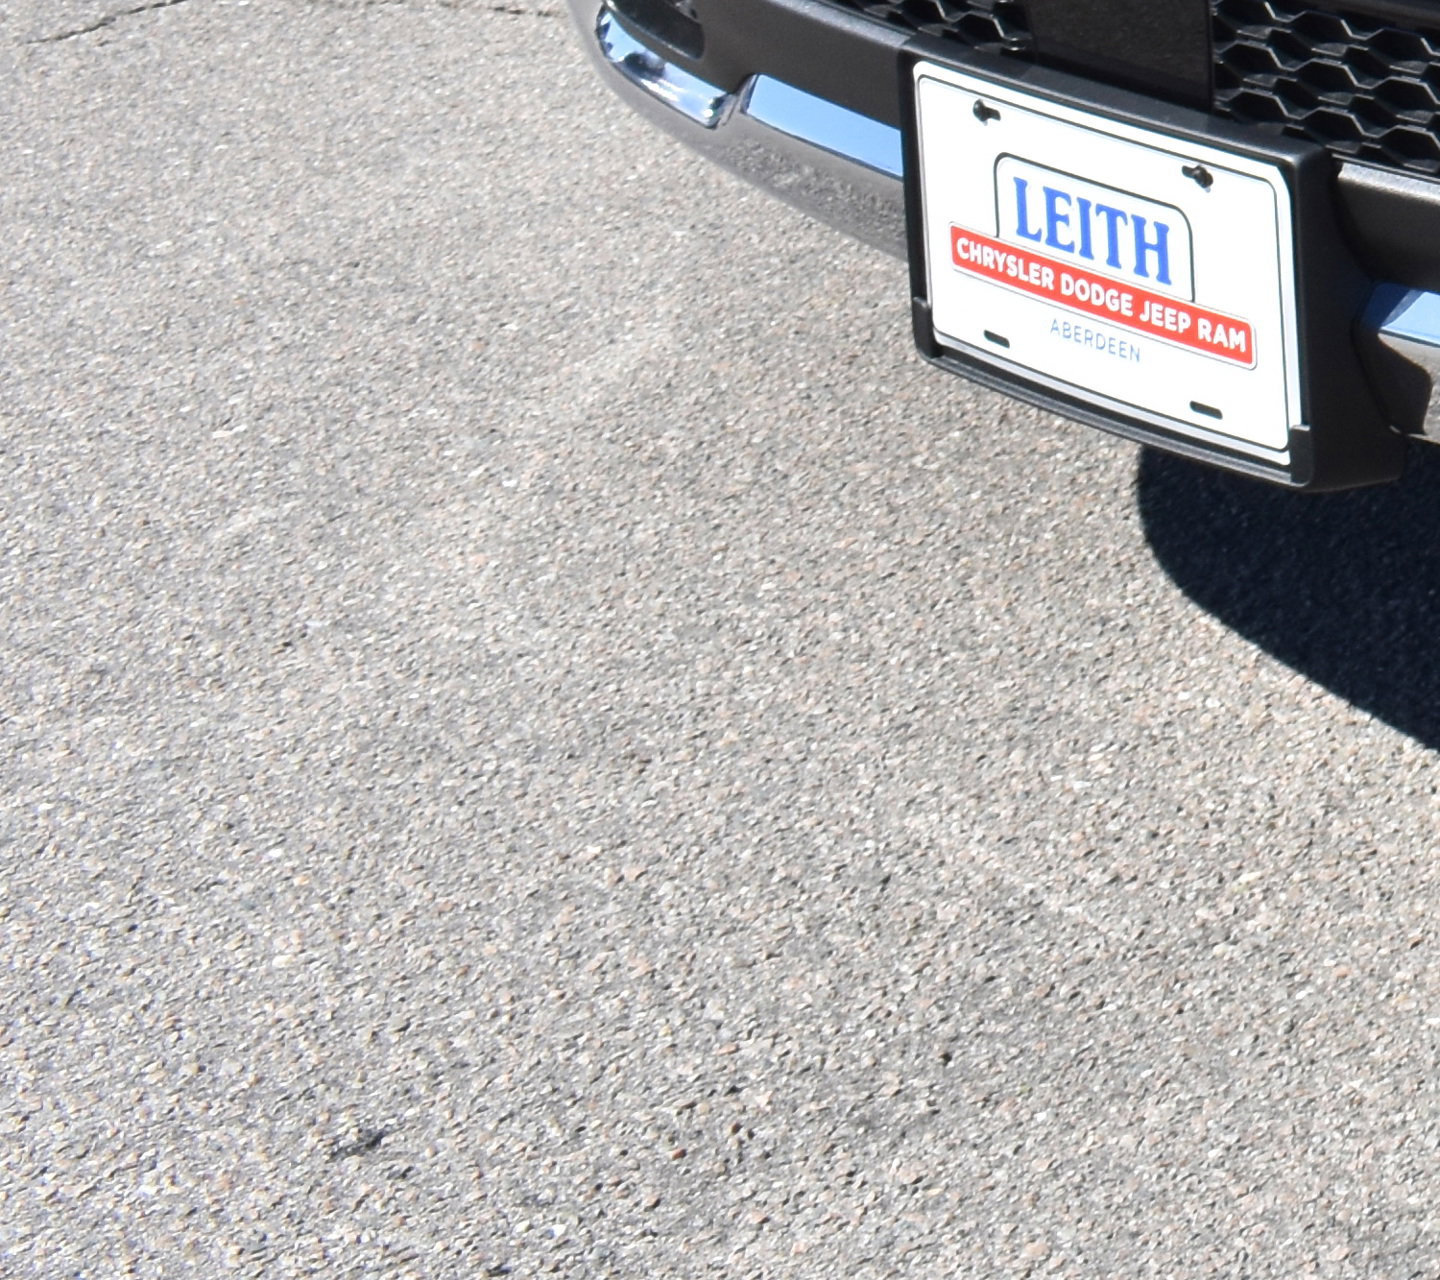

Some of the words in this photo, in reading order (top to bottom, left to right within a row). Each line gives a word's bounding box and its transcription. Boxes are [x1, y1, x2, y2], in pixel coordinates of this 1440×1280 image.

[1013, 176, 1172, 285] LEITH
[956, 237, 1055, 290] CHRYSLER
[1061, 274, 1133, 316] DODGE
[1139, 301, 1191, 333] JEEP
[1197, 318, 1247, 352] RAM
[1050, 318, 1142, 363] ABERDEEN
